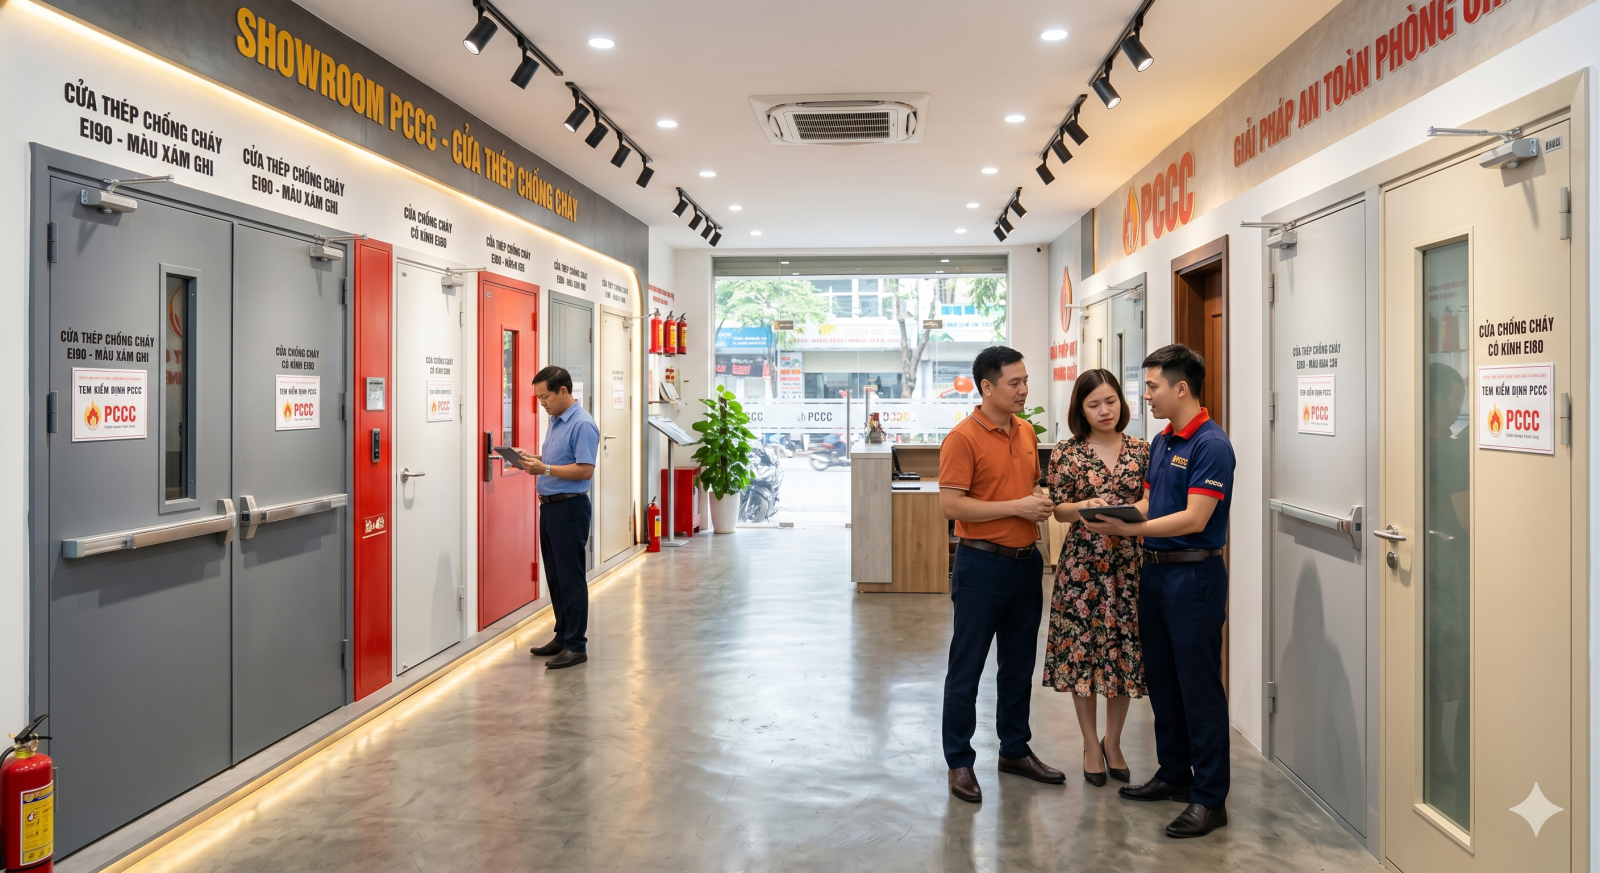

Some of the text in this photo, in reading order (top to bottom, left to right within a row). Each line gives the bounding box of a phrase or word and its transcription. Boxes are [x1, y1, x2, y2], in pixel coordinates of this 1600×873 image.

[1233, 117, 1258, 168] GIẢI
[1260, 97, 1296, 153] PHÁP
[1298, 80, 1320, 129] AN
[1323, 48, 1371, 112] TOÀN
[1375, 0, 1456, 81] PHÒNG
[64, 78, 222, 155] CỬA THÉP CHỐNG CHÁY
[236, 7, 578, 223] SHOWROOM PCCC - CỬA THÉP CHỐNG CHÁY
[79, 117, 112, 145] EI90
[127, 133, 158, 159] MÀU
[161, 144, 191, 170] XÁM
[194, 156, 214, 177] GHI
[243, 145, 345, 197] CỬA THÉP CHỐNG CHÁY
[282, 183, 301, 203] MÀU
[304, 191, 323, 210] XÁM
[325, 198, 338, 215] GHI
[1141, 152, 1195, 247] PCCC
[1478, 314, 1554, 338] CỬA CHỐNG CHÁY
[60, 327, 155, 348] CỬA THÉP CHỐNG CHÁY
[1488, 340, 1499, 357] CÓ
[1501, 339, 1521, 356] KÍNH
[67, 347, 86, 360] EI90
[95, 347, 114, 361] MÀU
[115, 348, 134, 362] XÁM
[136, 351, 149, 363] GHI
[78, 385, 92, 395] TEM
[126, 386, 142, 395] PCCC
[1482, 385, 1493, 396] TEM
[1529, 384, 1548, 396] PCCC
[104, 405, 136, 422] PCCC
[294, 403, 314, 417] PCCC
[808, 411, 833, 422] PCCC
[1311, 405, 1329, 421] PCCC
[1506, 409, 1540, 432] PCCC
